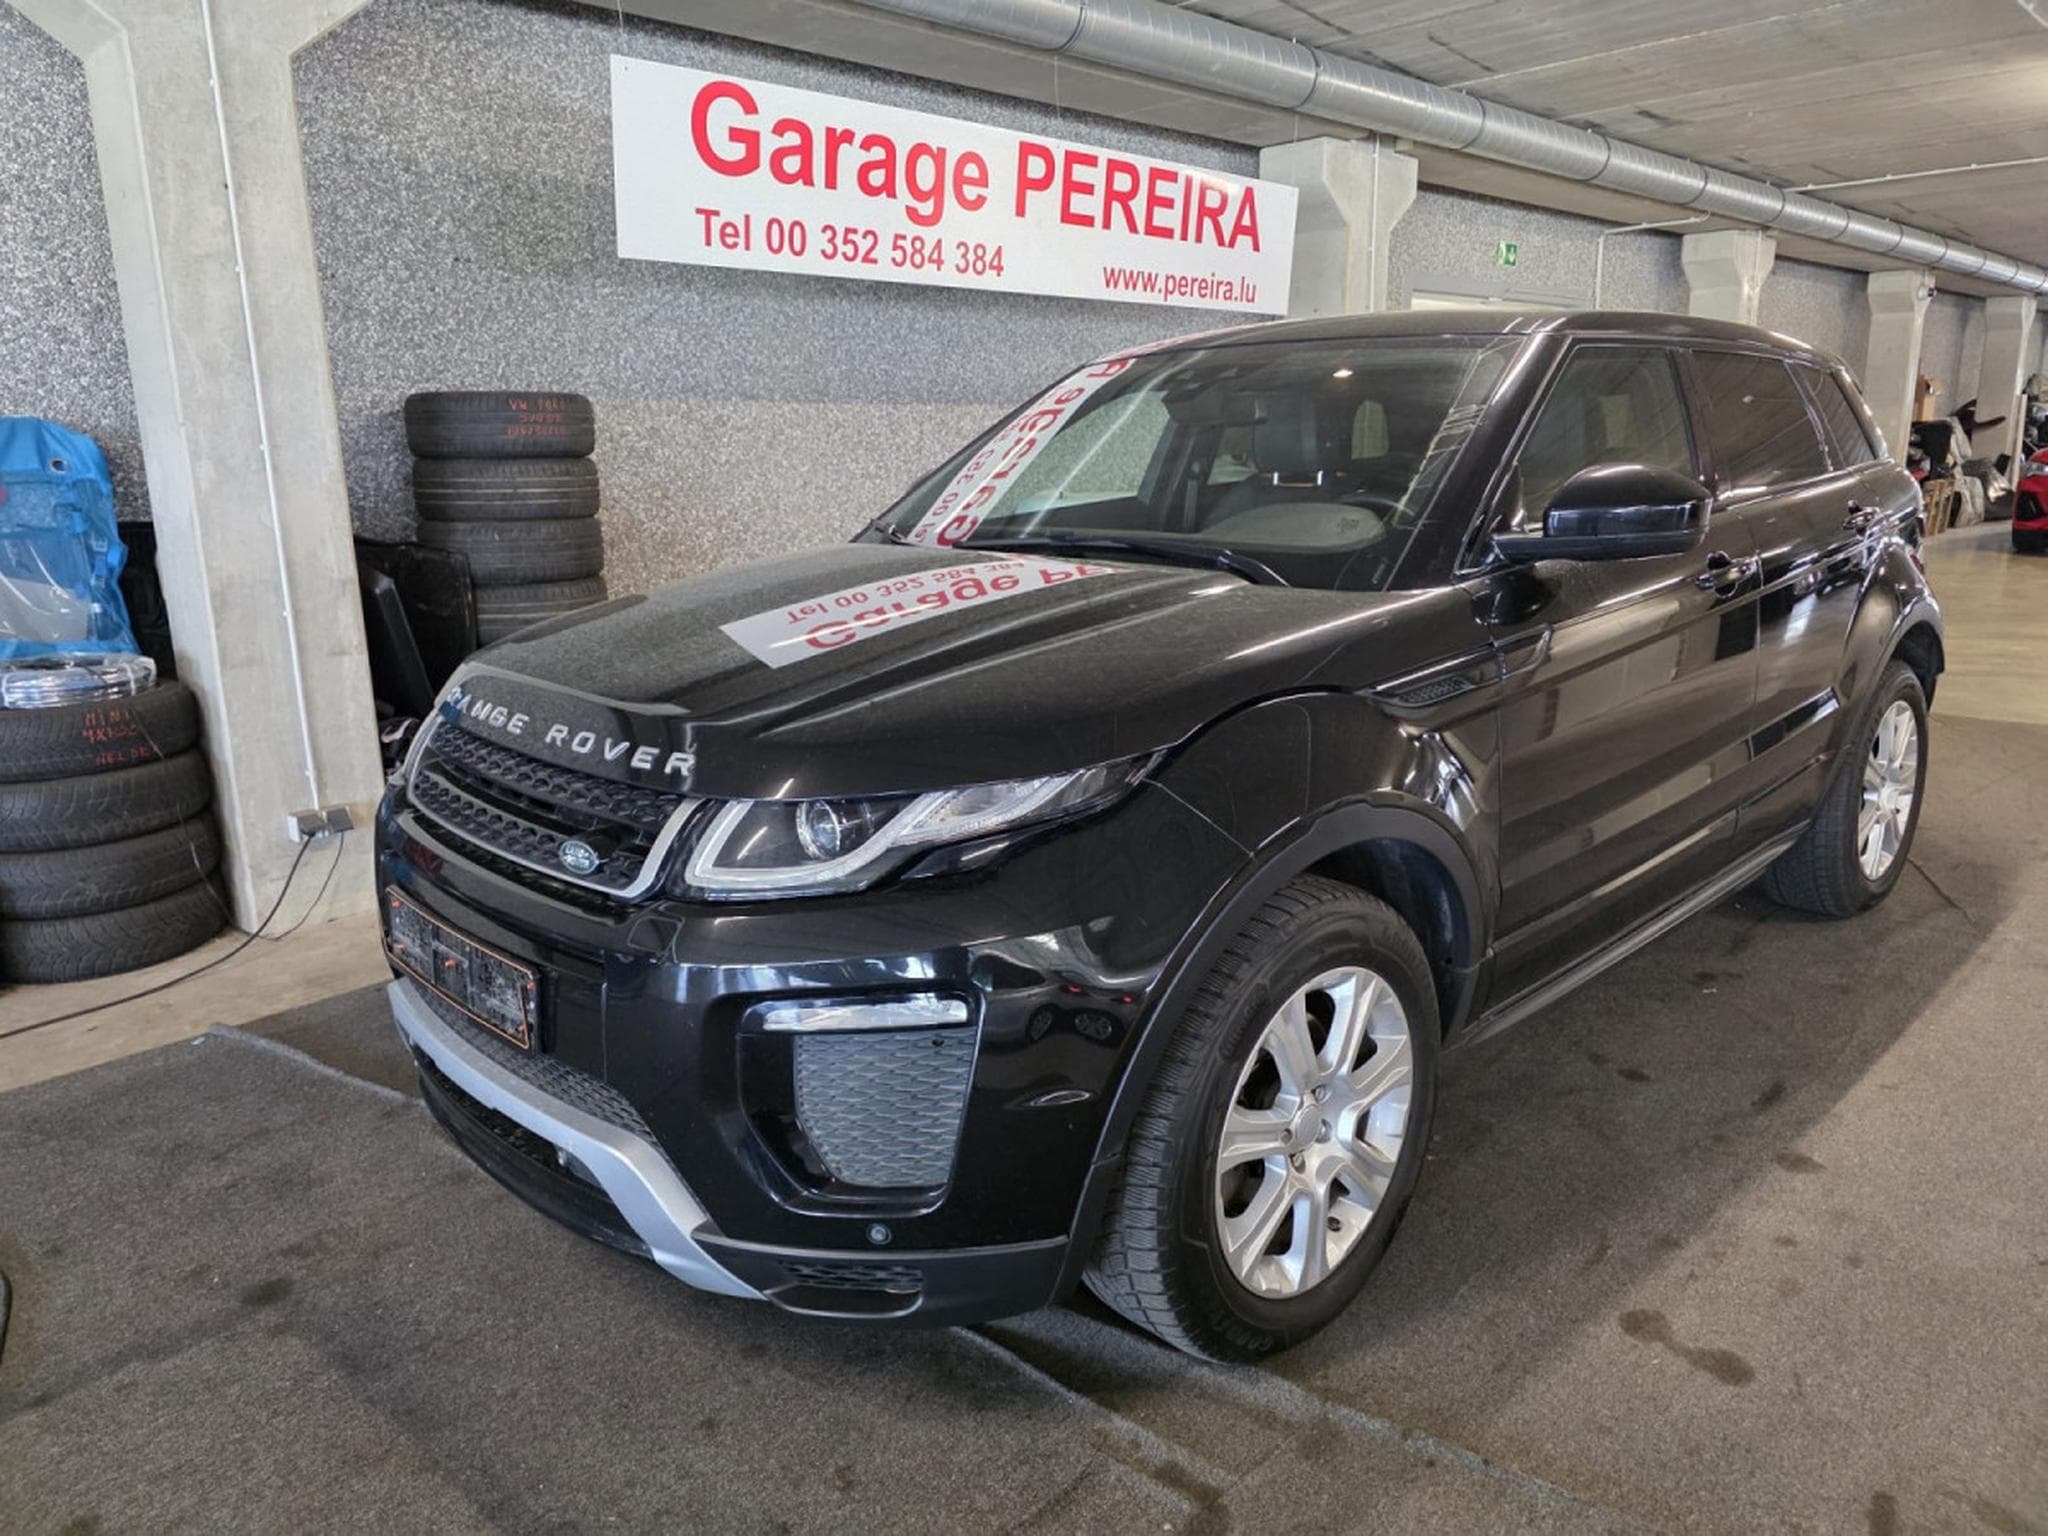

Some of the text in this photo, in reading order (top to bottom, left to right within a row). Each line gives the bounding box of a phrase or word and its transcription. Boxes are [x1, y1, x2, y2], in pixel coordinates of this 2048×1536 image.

[689, 80, 1262, 255] Garage PEREIRA
[693, 206, 1005, 278] Tel 00 352 584 384
[1103, 266, 1257, 305] www.pereira.lu
[545, 723, 698, 777] ROVER
